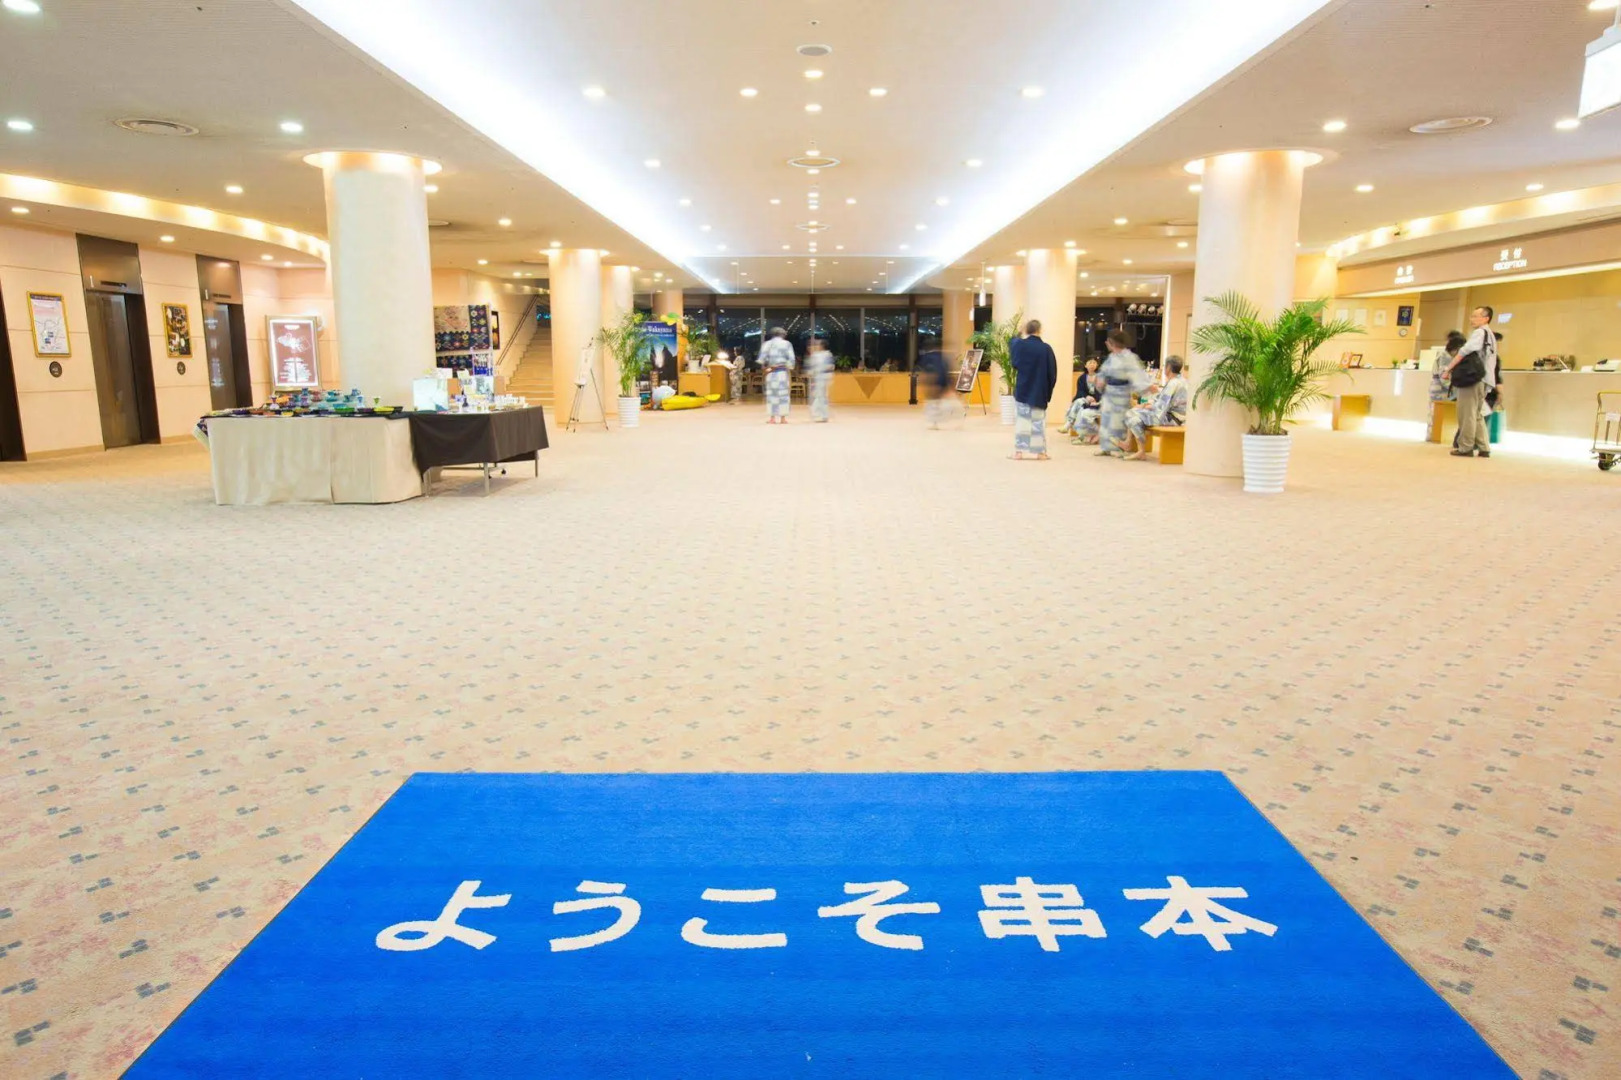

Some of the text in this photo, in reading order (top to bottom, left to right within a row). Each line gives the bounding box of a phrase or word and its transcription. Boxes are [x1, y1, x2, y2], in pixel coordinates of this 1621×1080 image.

[376, 875, 1278, 952] ようこそ串本
